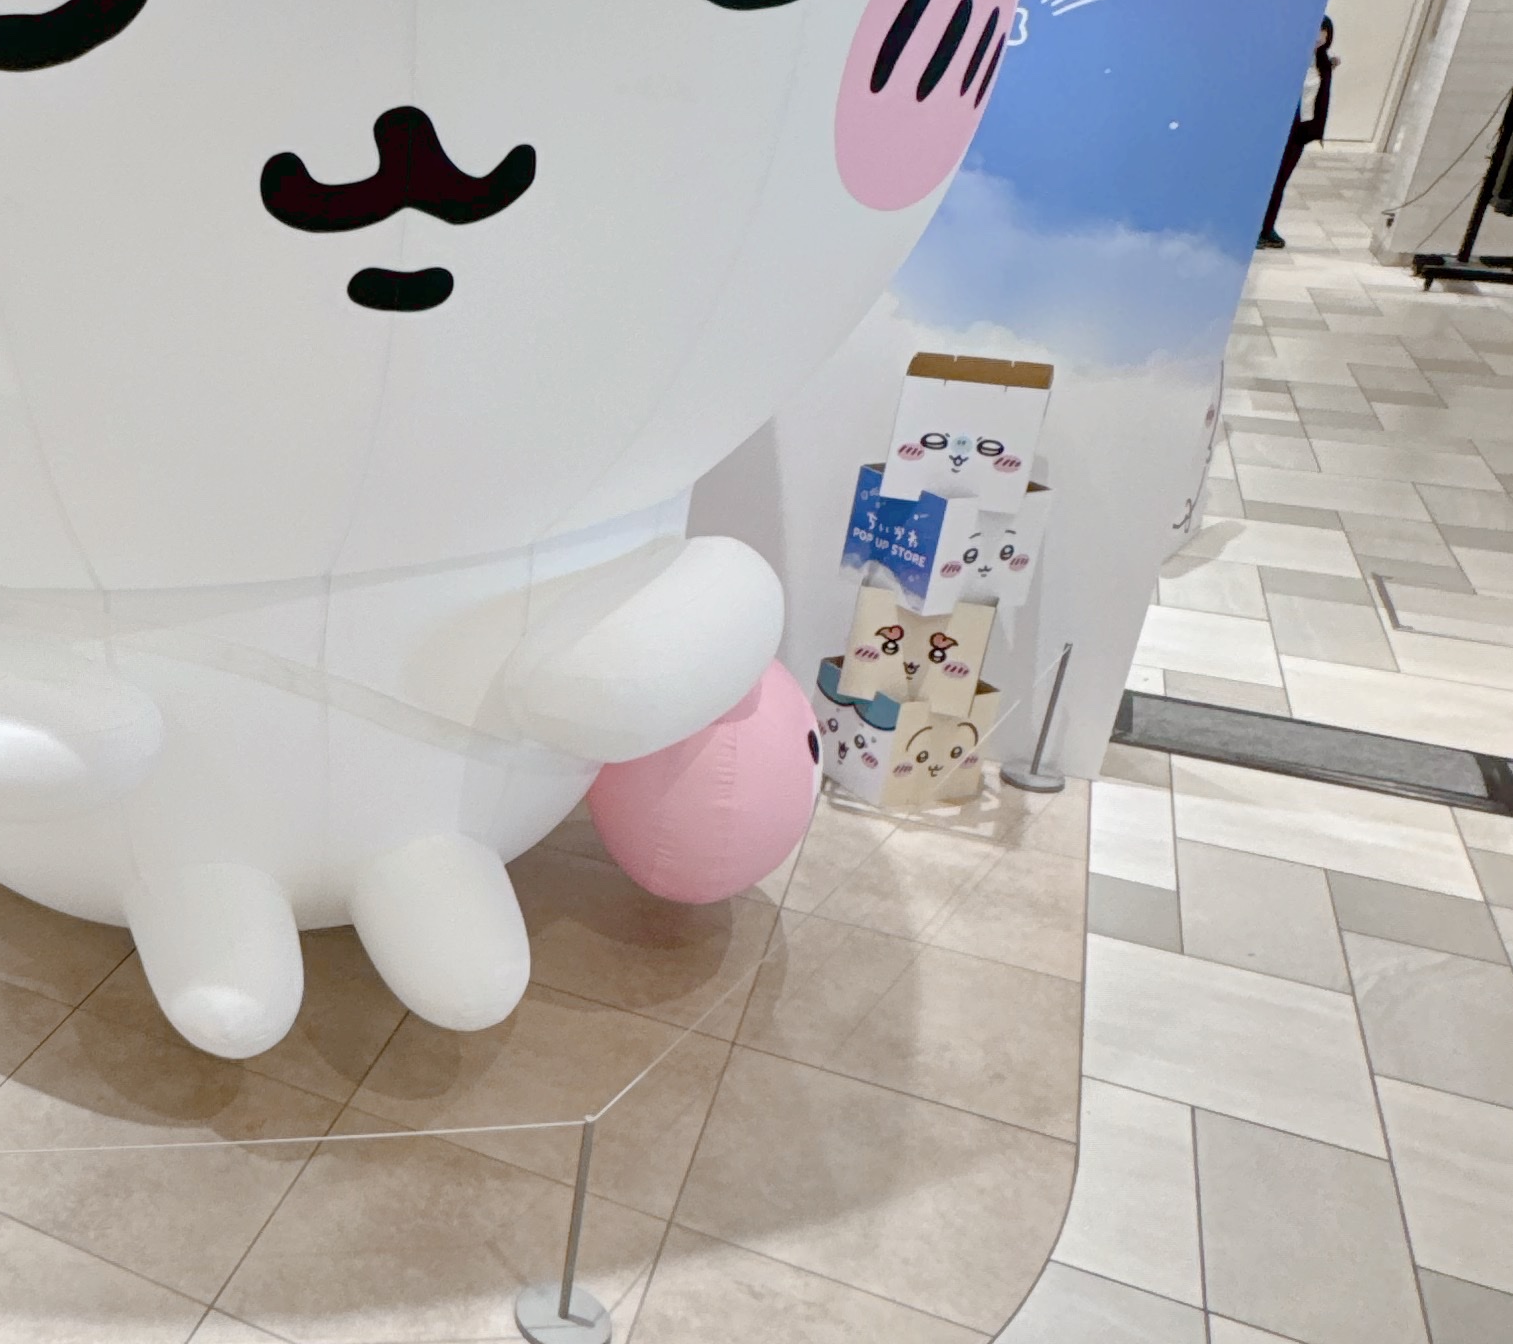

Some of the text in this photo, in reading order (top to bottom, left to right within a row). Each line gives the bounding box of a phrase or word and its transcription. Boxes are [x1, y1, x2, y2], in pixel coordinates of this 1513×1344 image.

[853, 526, 926, 568] POP UP STORE
[866, 511, 918, 548] ちいかわ
